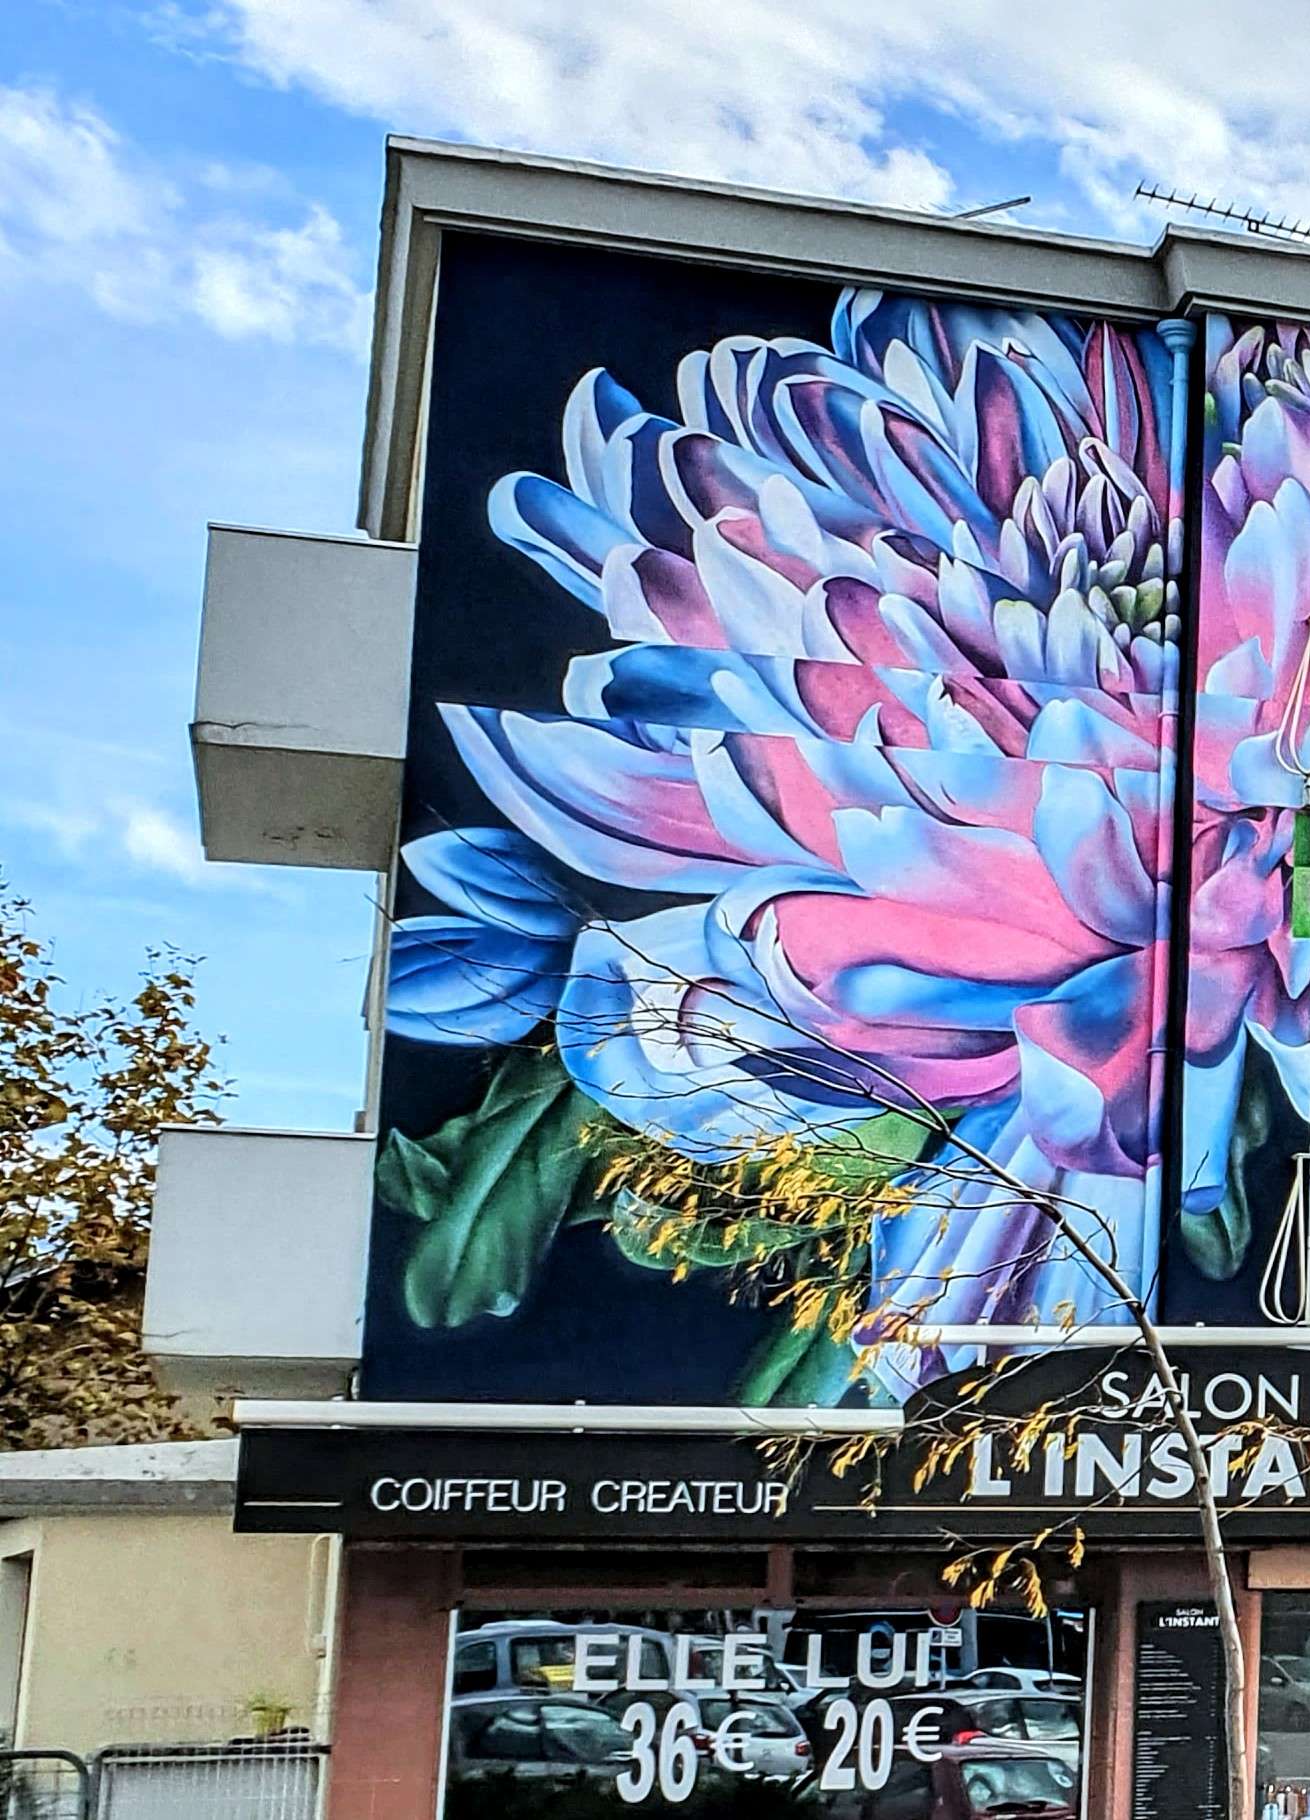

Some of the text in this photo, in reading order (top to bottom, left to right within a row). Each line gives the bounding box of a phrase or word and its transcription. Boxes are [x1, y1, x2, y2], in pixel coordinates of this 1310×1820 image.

[1100, 1371, 1299, 1420] SALON
[370, 1477, 789, 1515] COIFFEUR CREATEUR
[1159, 1616, 1220, 1628] L'INSTANT
[572, 1632, 931, 1692] ELLE LUI
